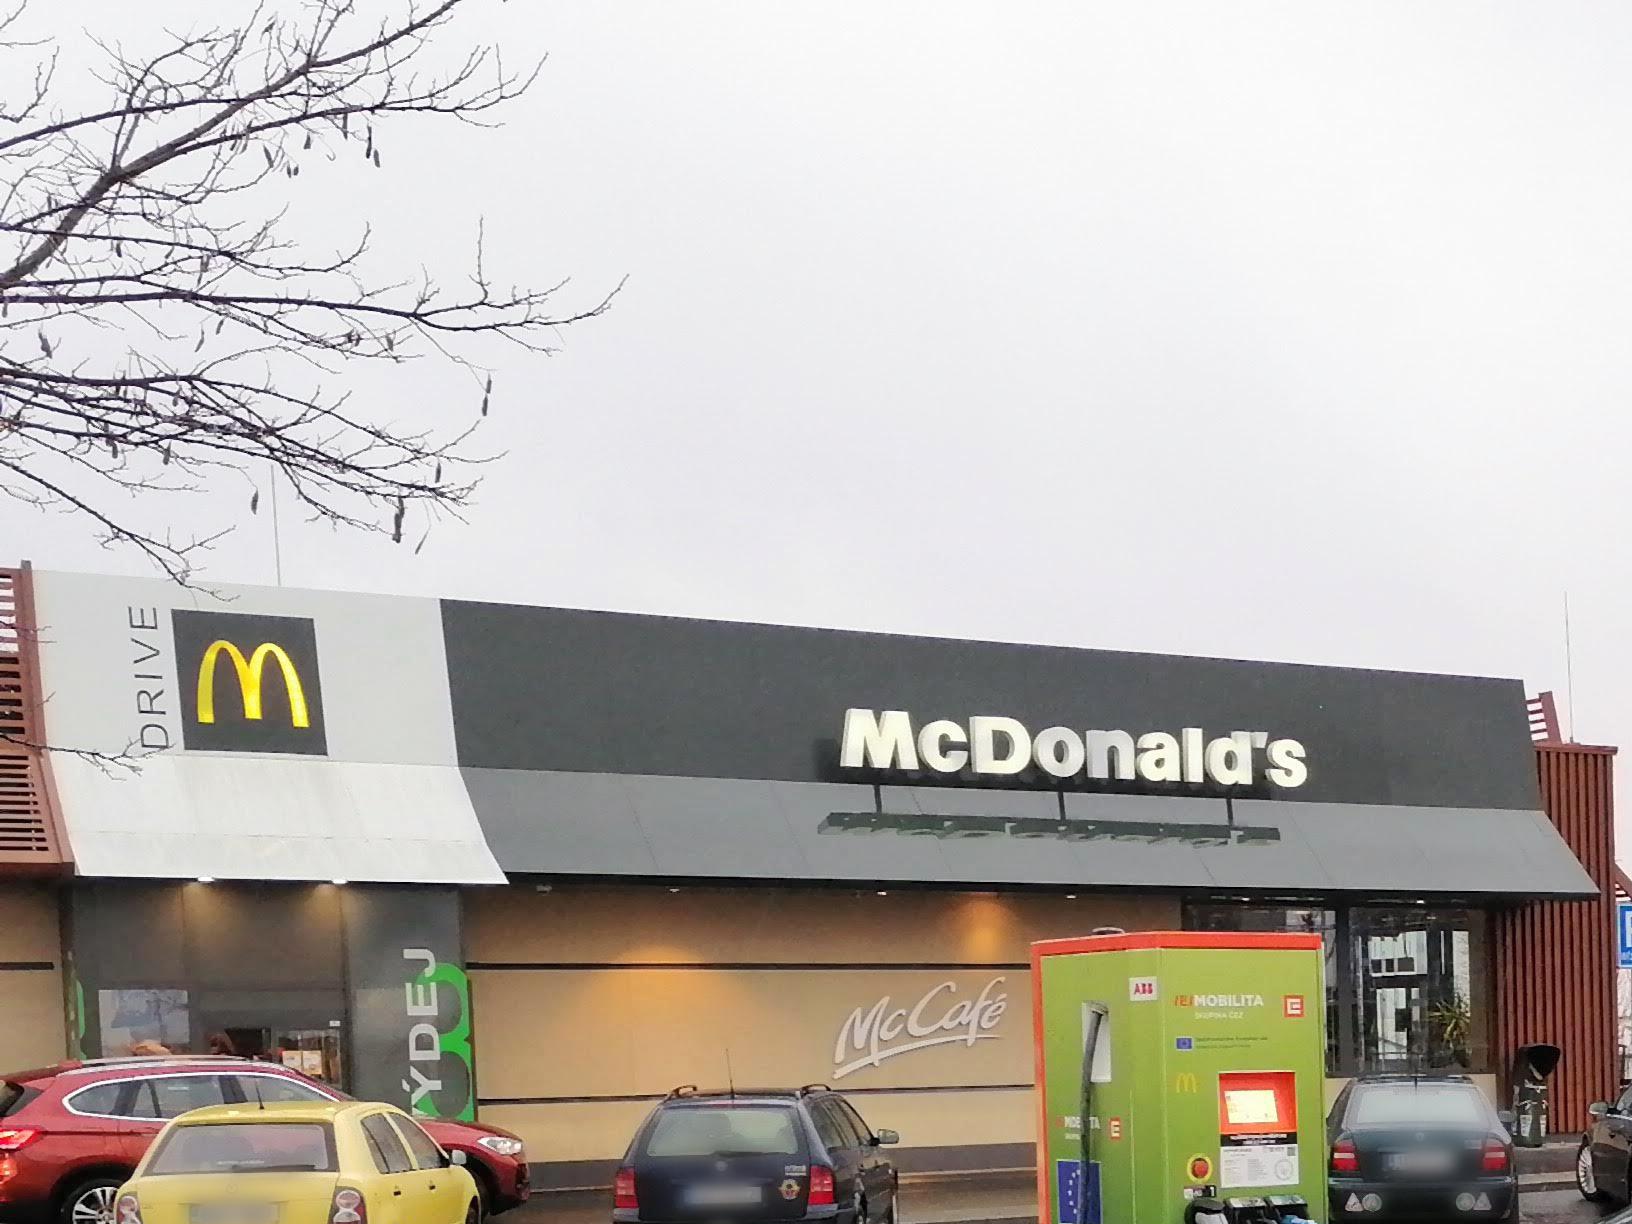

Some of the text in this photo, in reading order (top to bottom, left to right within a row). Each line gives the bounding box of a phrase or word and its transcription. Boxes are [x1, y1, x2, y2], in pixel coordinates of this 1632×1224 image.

[128, 606, 170, 749] DRIVE
[840, 707, 1308, 788] McDonald's
[833, 976, 1008, 1068] McCafé
[1133, 982, 1154, 995] ABB
